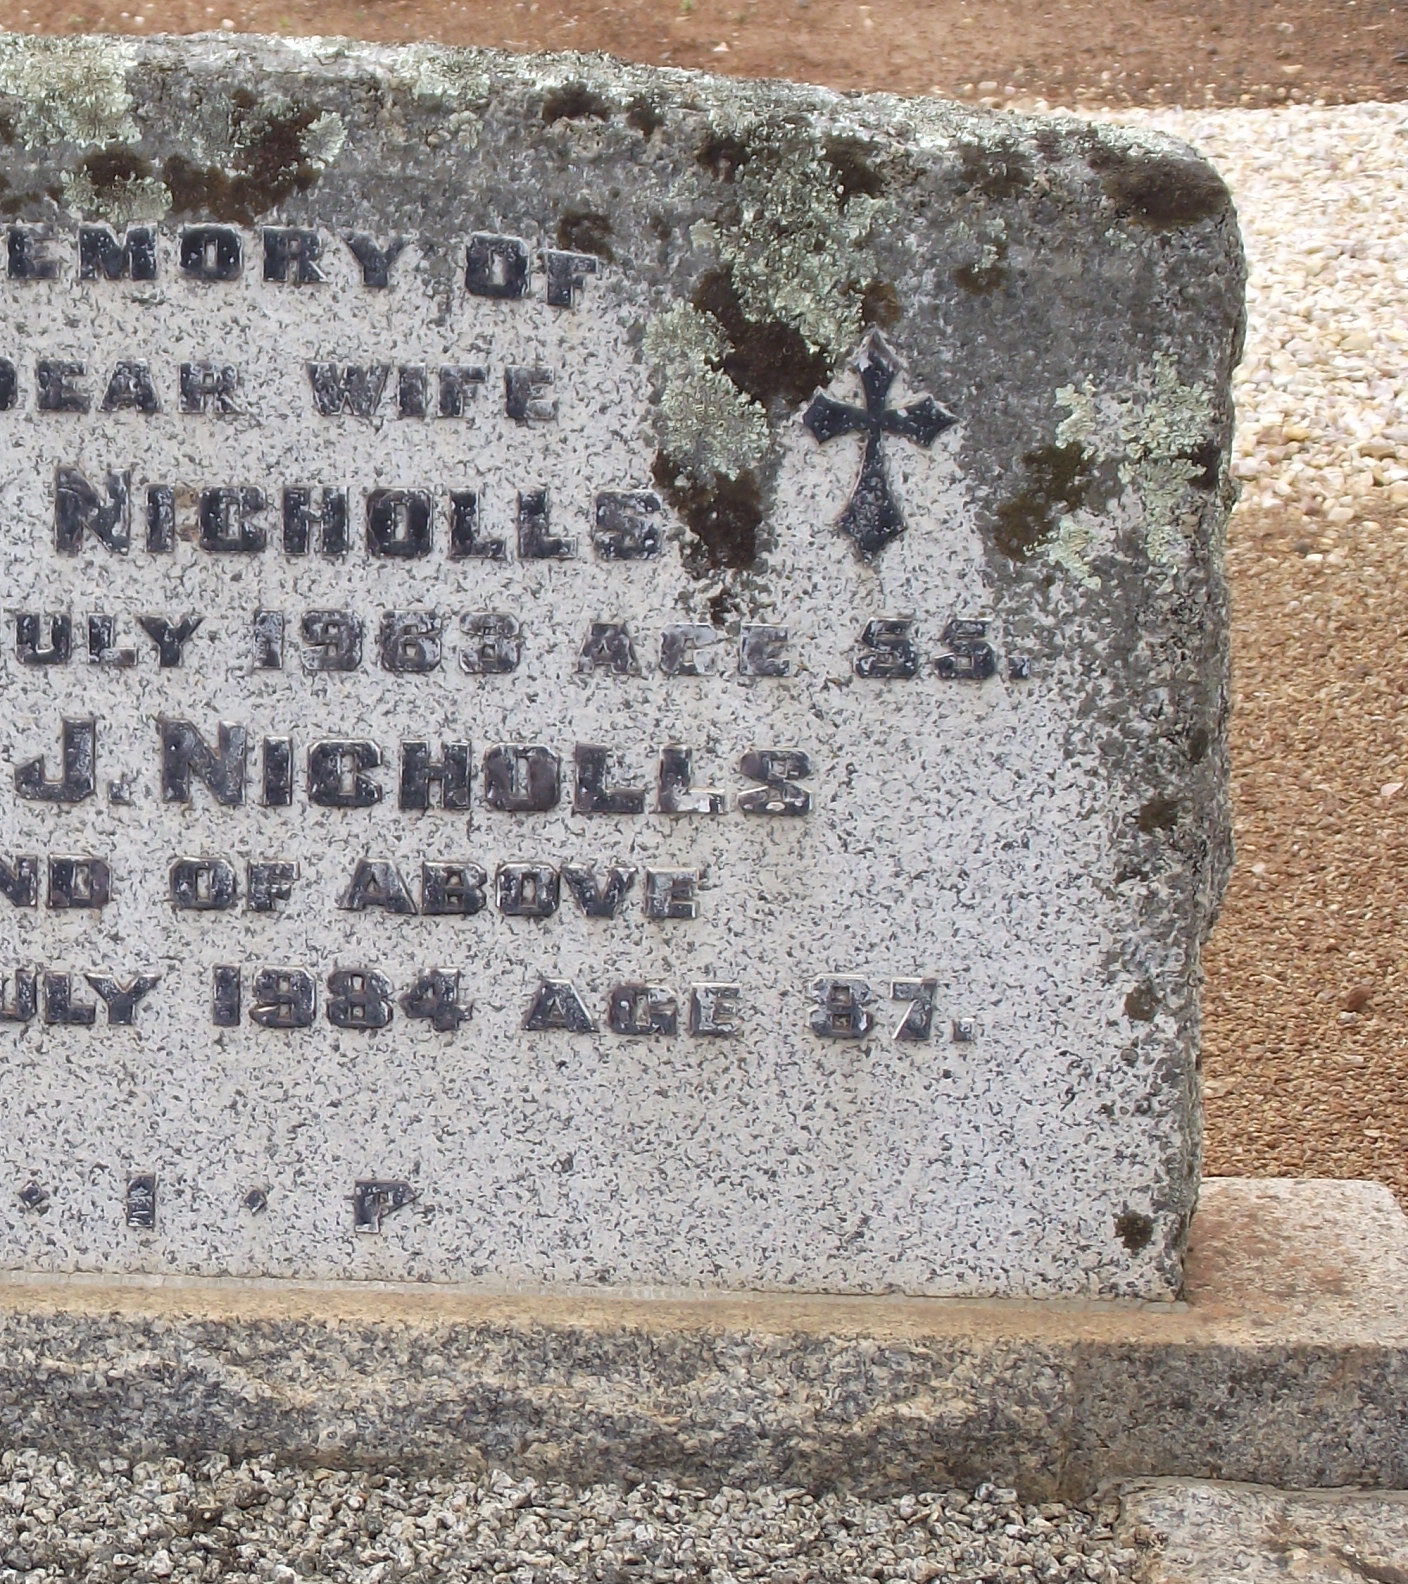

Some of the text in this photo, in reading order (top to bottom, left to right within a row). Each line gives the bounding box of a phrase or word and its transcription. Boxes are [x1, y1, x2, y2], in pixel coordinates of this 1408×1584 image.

[465, 232, 599, 306] OF
[306, 359, 559, 421] WIFE
[54, 466, 665, 560] NICHOLLS
[254, 608, 521, 675] 1963
[169, 856, 299, 911] OF
[338, 858, 700, 918] ABOVE
[213, 963, 473, 1033] 1984
[521, 976, 742, 1038] AGE
